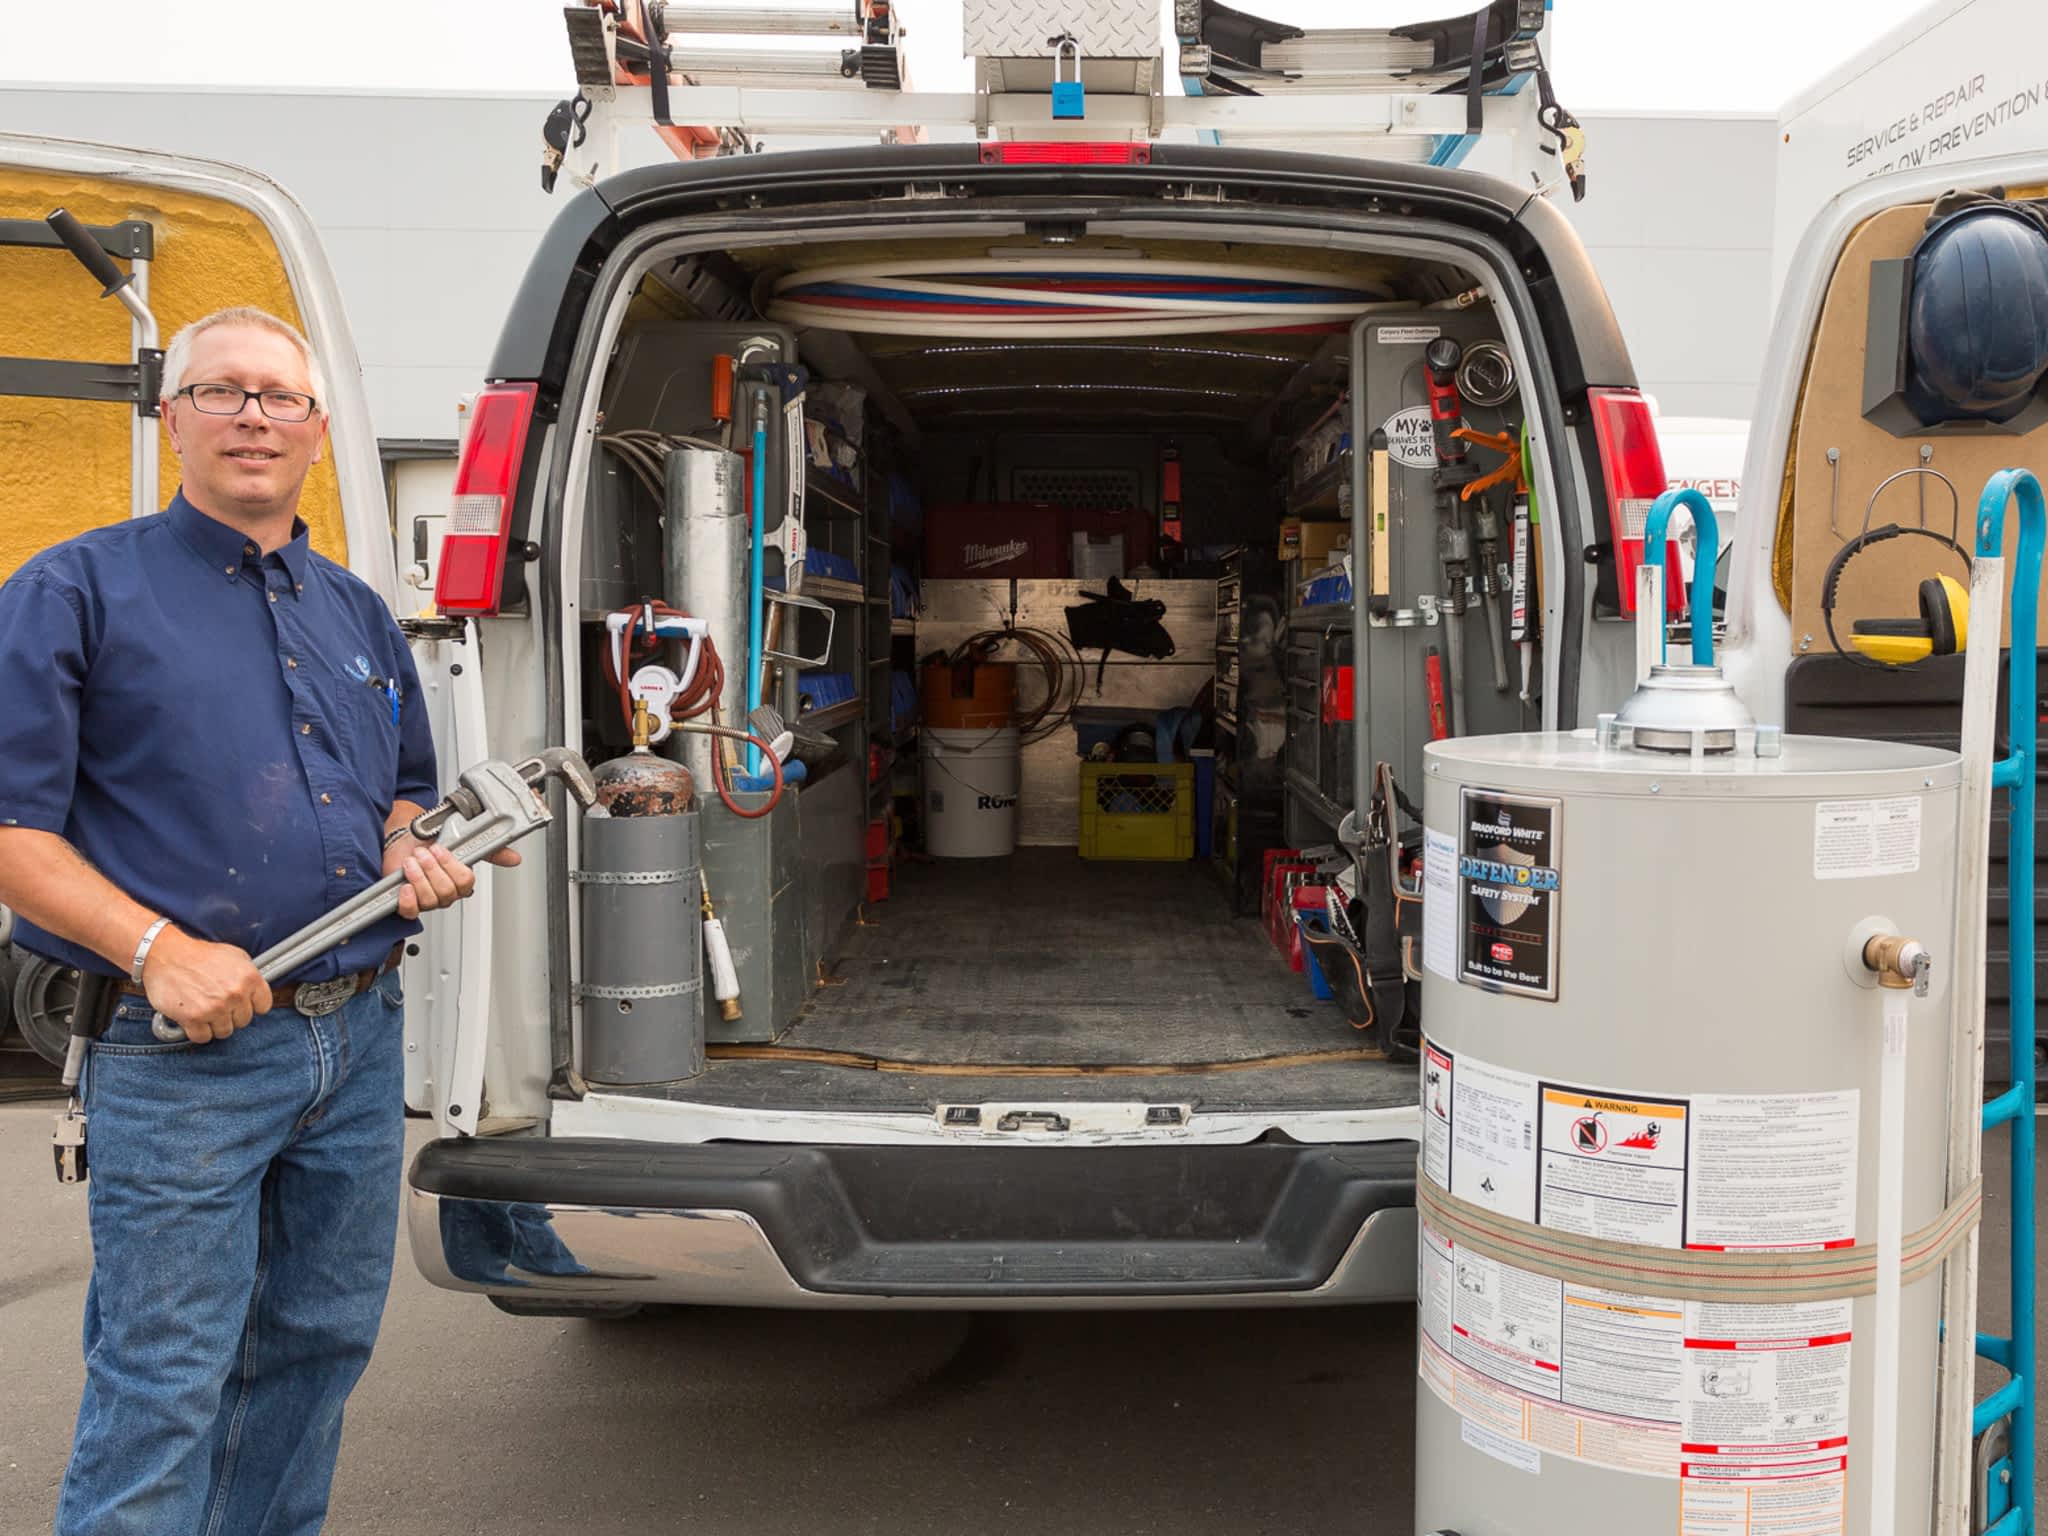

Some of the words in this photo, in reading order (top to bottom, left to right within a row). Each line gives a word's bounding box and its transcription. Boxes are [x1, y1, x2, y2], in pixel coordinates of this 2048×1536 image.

[1847, 118, 1906, 168] SERVICE
[1910, 113, 1919, 132] &
[1923, 74, 1985, 126] REPAIR
[1929, 83, 2040, 161] PREVENTION
[1395, 418, 1418, 436] MY
[963, 539, 1028, 566] Milwaukee
[1470, 820, 1512, 837] BRADFORD
[1512, 826, 1544, 841] WHITE
[1459, 855, 1560, 891] DEFENDER
[1470, 884, 1500, 900] SAFETY
[1501, 889, 1539, 905] SYSTEM
[1468, 960, 1483, 972] Built
[1483, 964, 1492, 974] to
[1492, 966, 1503, 977] be
[1503, 969, 1517, 980] the
[1519, 972, 1540, 984] Best
[1594, 1101, 1639, 1114] WARNING
